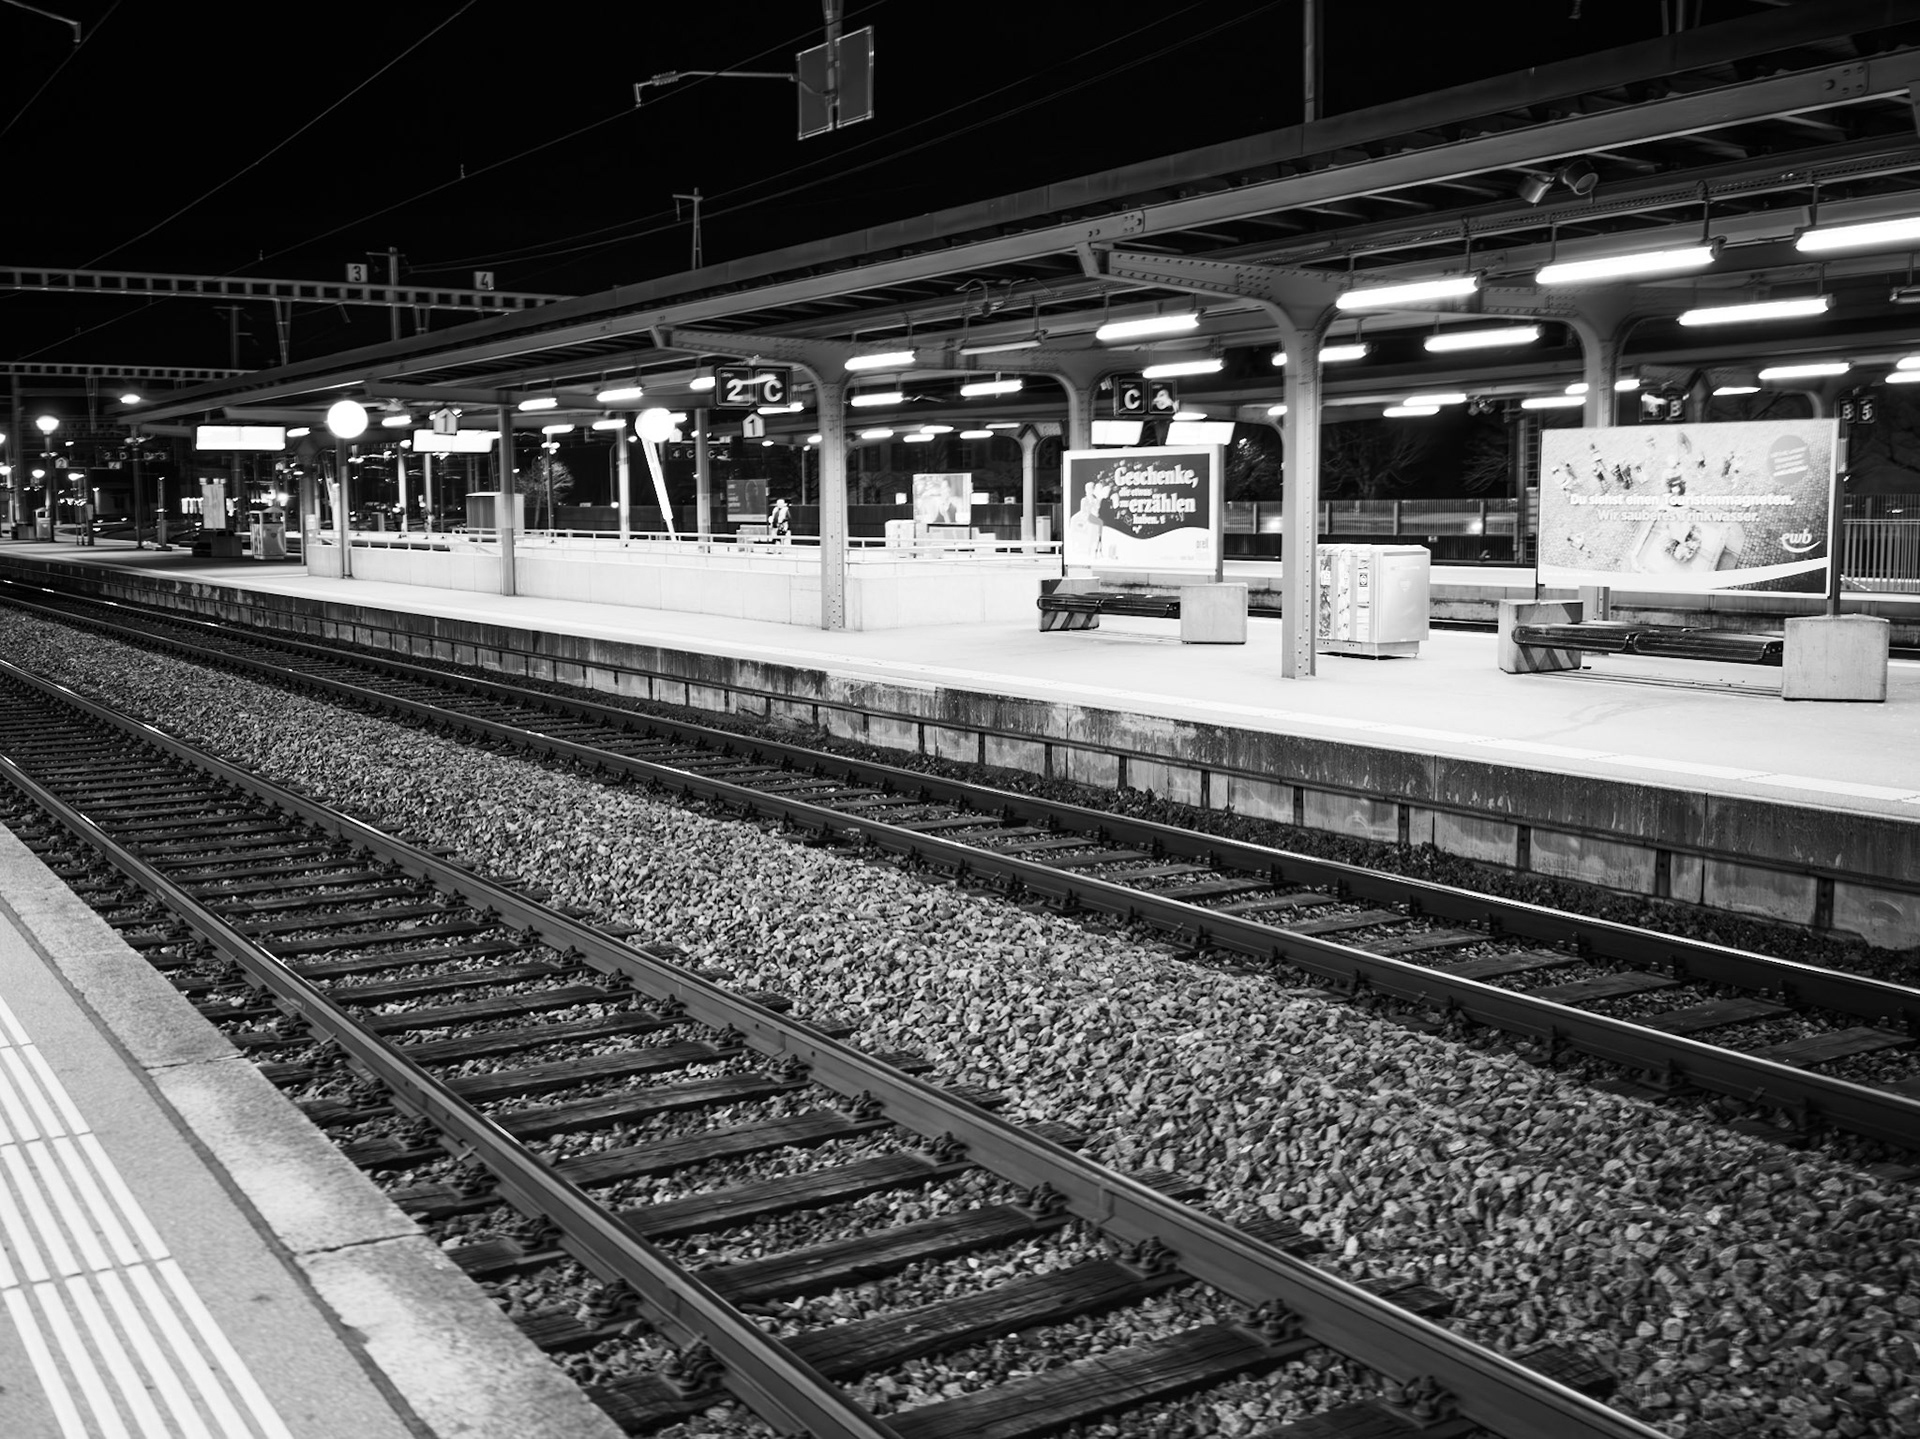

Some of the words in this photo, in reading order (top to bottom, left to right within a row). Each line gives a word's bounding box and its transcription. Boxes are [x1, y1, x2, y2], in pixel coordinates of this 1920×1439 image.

[352, 265, 362, 282] 3
[481, 273, 489, 288] 4
[726, 378, 744, 401] 2
[763, 379, 784, 402] C
[1124, 388, 1141, 410] C
[1861, 403, 1873, 421] 5
[441, 413, 449, 432] 1
[748, 418, 756, 436] 1
[1114, 464, 1199, 488] Geschenke,
[1129, 493, 1197, 513] erzählen
[1570, 494, 1587, 505] Du
[1588, 494, 1624, 505] siehst
[1625, 494, 1659, 505] einen
[1662, 493, 1796, 508] Touristenmagneten.
[1597, 509, 1618, 521] Wir
[1620, 509, 1676, 521] sauberes
[1677, 509, 1760, 522] Trinkwasser.
[1779, 527, 1816, 549] ewb
